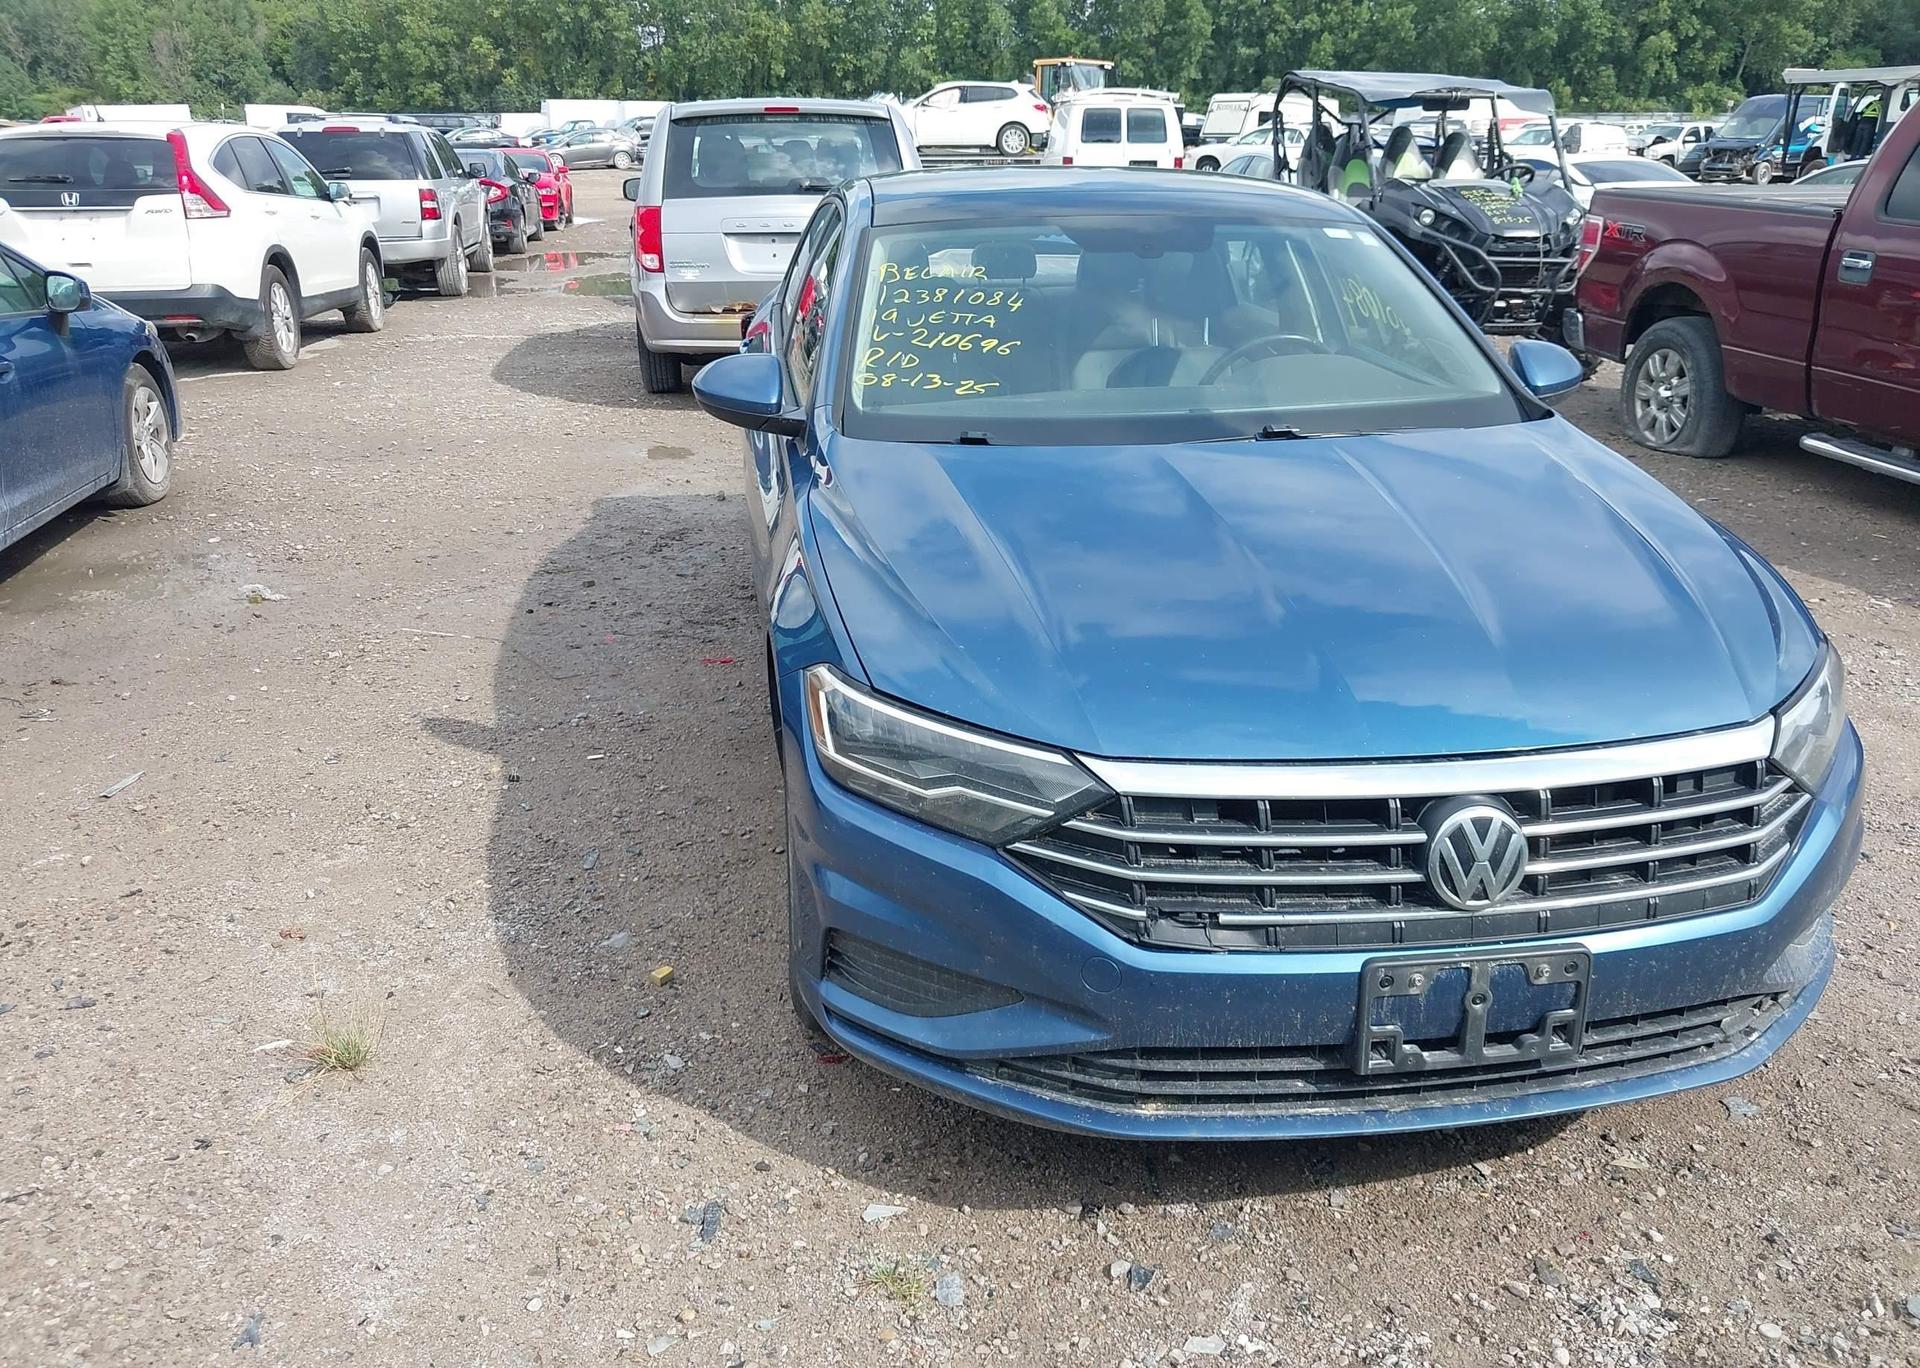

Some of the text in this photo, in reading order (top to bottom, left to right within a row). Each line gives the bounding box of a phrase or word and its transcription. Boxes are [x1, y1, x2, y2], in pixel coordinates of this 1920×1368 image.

[1603, 219, 1647, 242] XTR
[879, 285, 1024, 312] 12381084
[906, 310, 997, 328] JETTA
[855, 372, 1000, 395] 08-13-25
